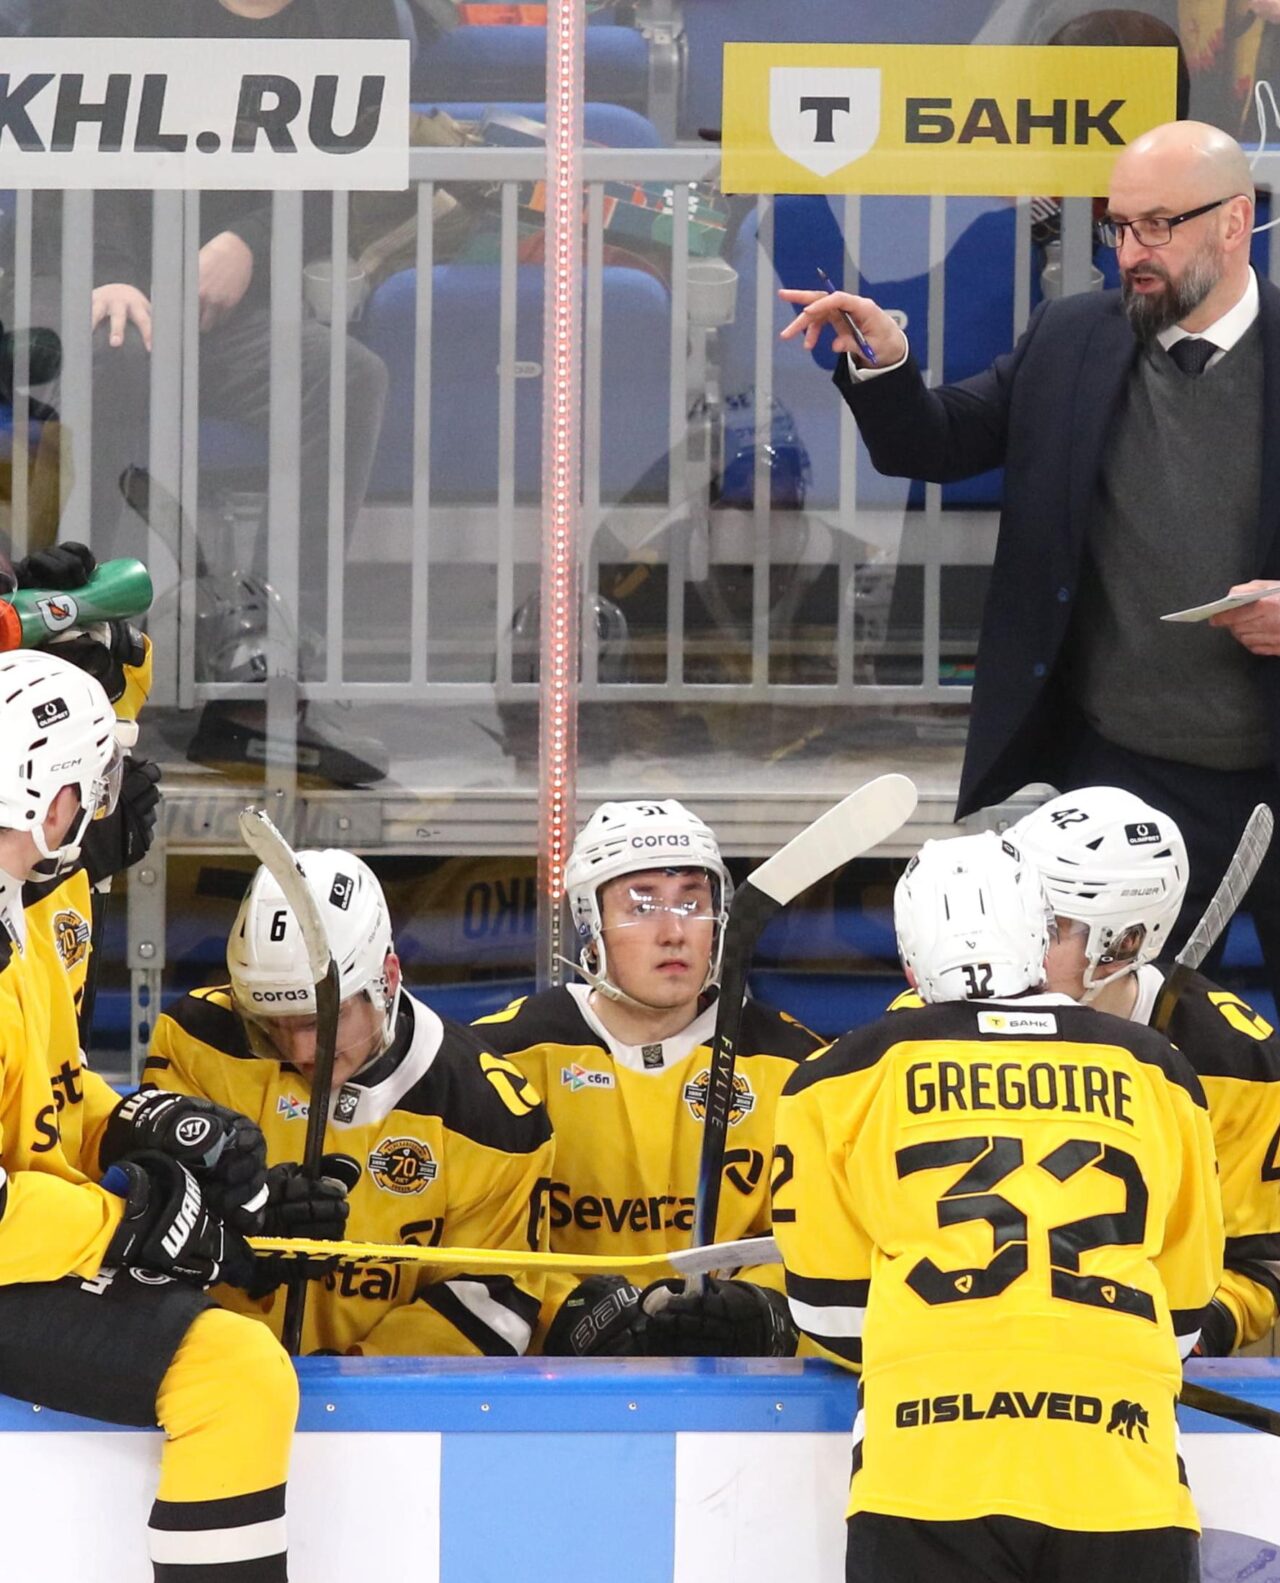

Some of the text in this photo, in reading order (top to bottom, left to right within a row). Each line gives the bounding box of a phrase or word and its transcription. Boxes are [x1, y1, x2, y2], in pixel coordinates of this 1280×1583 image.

[0, 73, 386, 154] KHL.RU
[904, 98, 1127, 146] БАНК
[50, 758, 82, 772] CCM
[1050, 808, 1090, 830] 42
[270, 910, 288, 942] 6
[962, 963, 995, 999] 32
[1009, 1019, 1049, 1028] БАНК
[711, 1034, 733, 1131] FLYLITE
[906, 1061, 1135, 1127] GREGOIRE
[391, 1155, 417, 1177] 70
[895, 1136, 1158, 1323] 32
[896, 1391, 1102, 1429] GISLAVED
